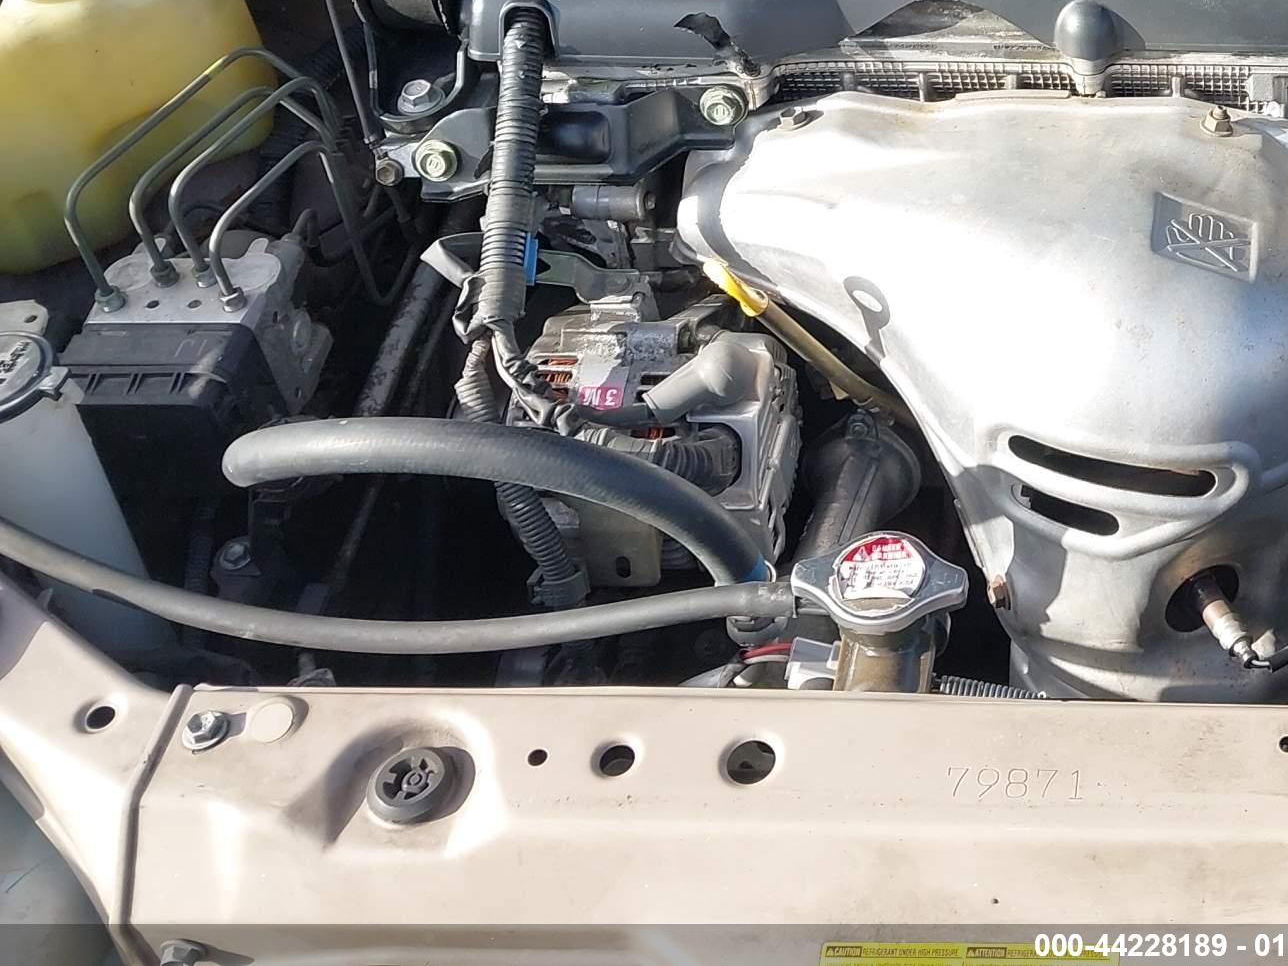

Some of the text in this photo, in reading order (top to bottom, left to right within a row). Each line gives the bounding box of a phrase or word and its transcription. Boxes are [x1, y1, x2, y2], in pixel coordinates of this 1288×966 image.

[604, 388, 618, 406] 3
[946, 765, 1085, 801] 79871
[834, 947, 959, 956] CAUTION REFRIGERANT UNDER HIGH PRESSURE
[975, 948, 1006, 957] ATTENTION
